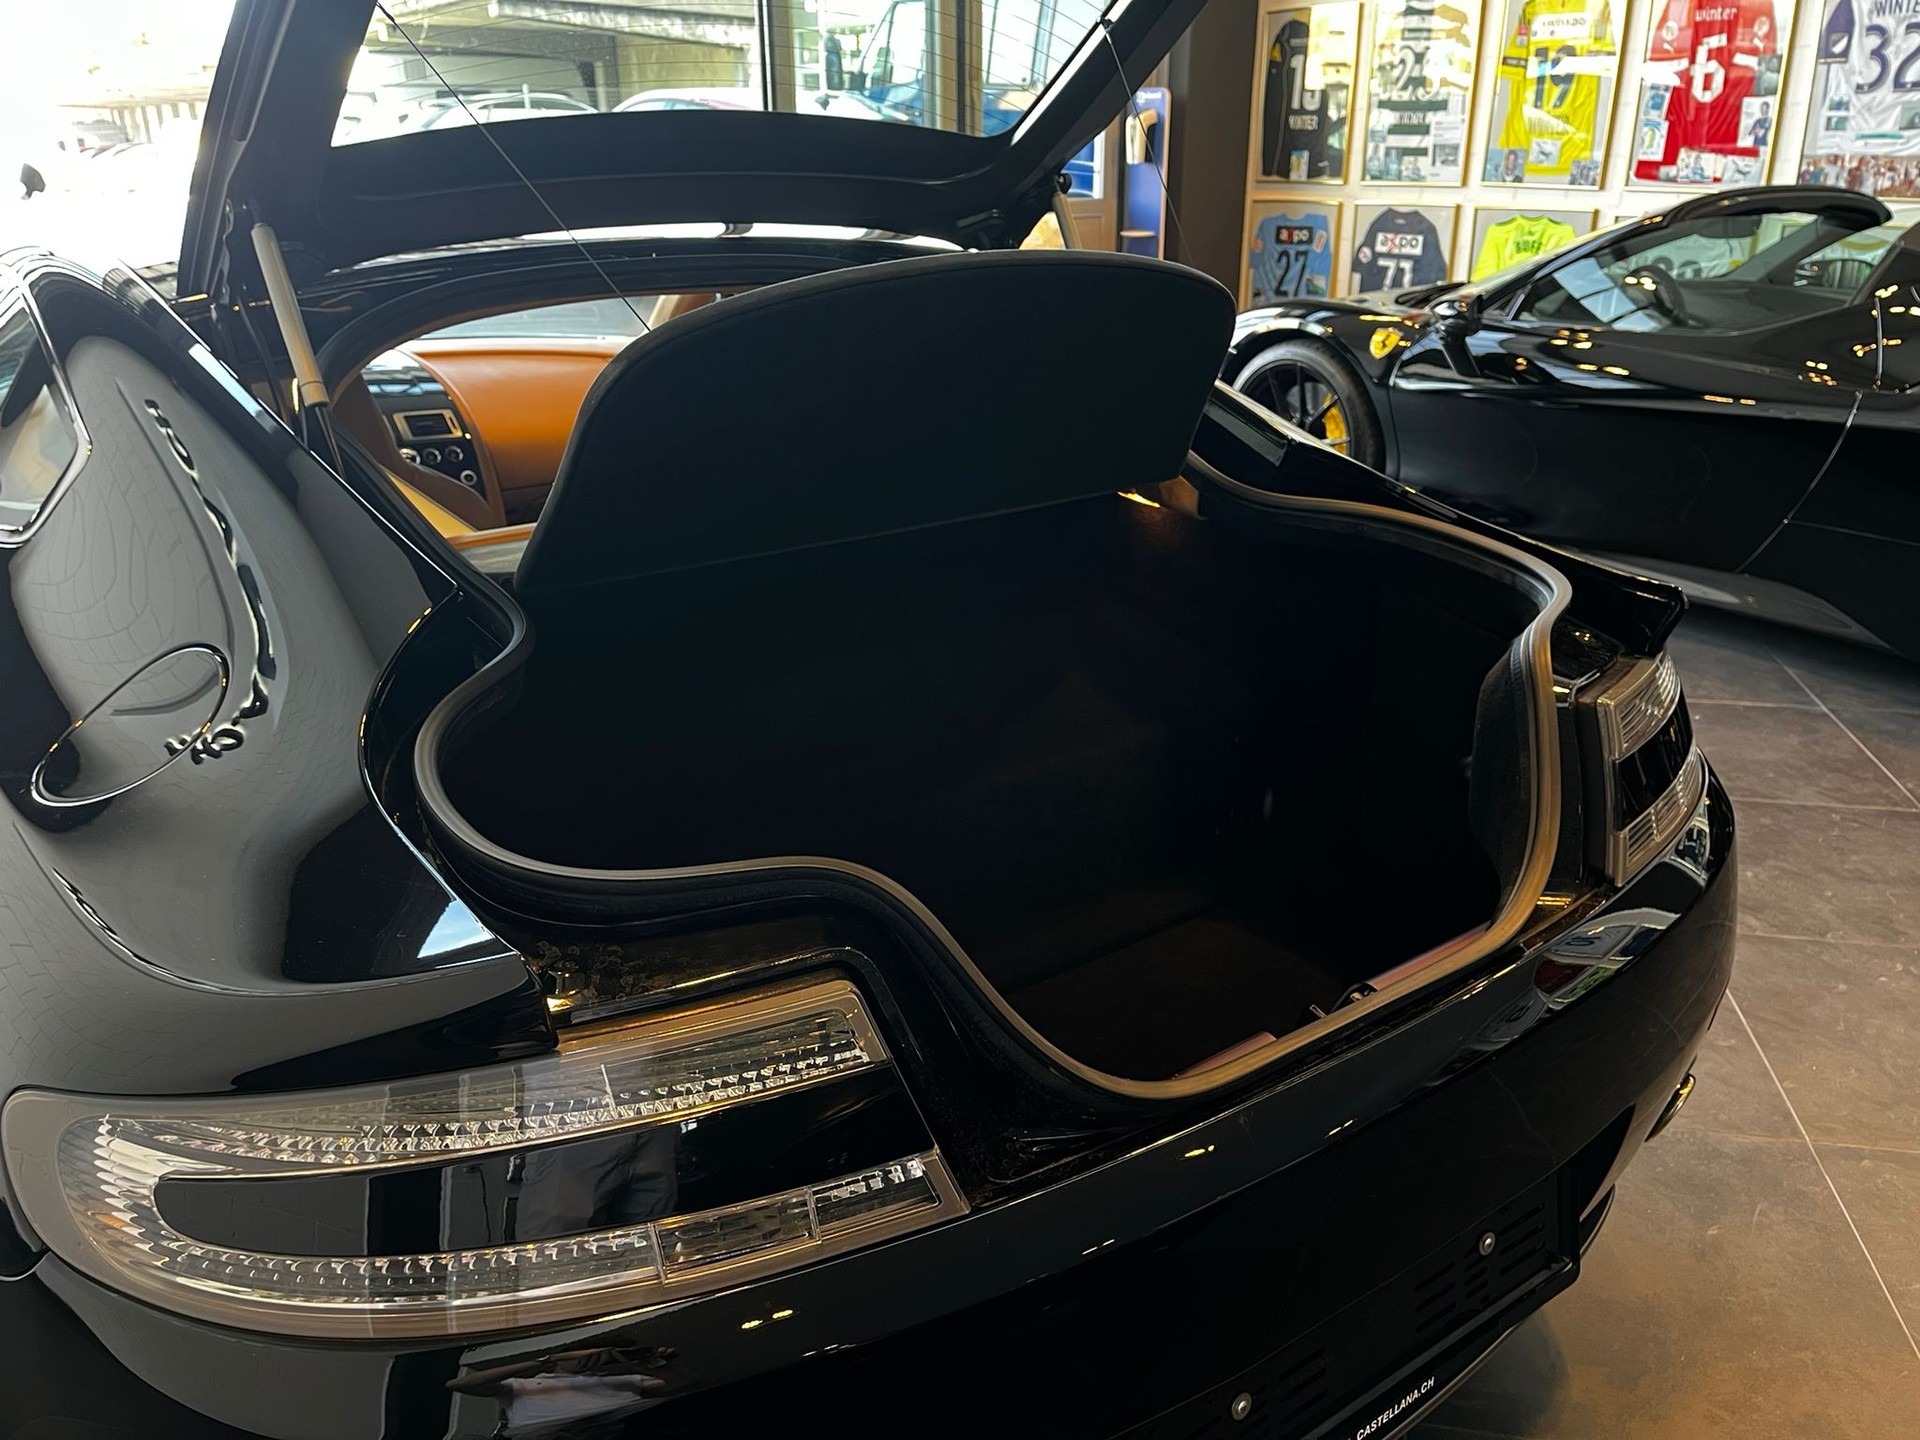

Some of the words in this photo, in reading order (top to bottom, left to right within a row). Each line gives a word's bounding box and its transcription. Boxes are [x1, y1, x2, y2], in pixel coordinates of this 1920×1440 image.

[1695, 6, 1738, 22] winter
[1690, 32, 1728, 104] 6
[1855, 22, 1920, 95] 32
[1379, 234, 1419, 253] axpo
[1274, 250, 1309, 298] 27
[1377, 258, 1415, 291] 71
[1356, 1376, 1436, 1440] CASTELLANA.CH
